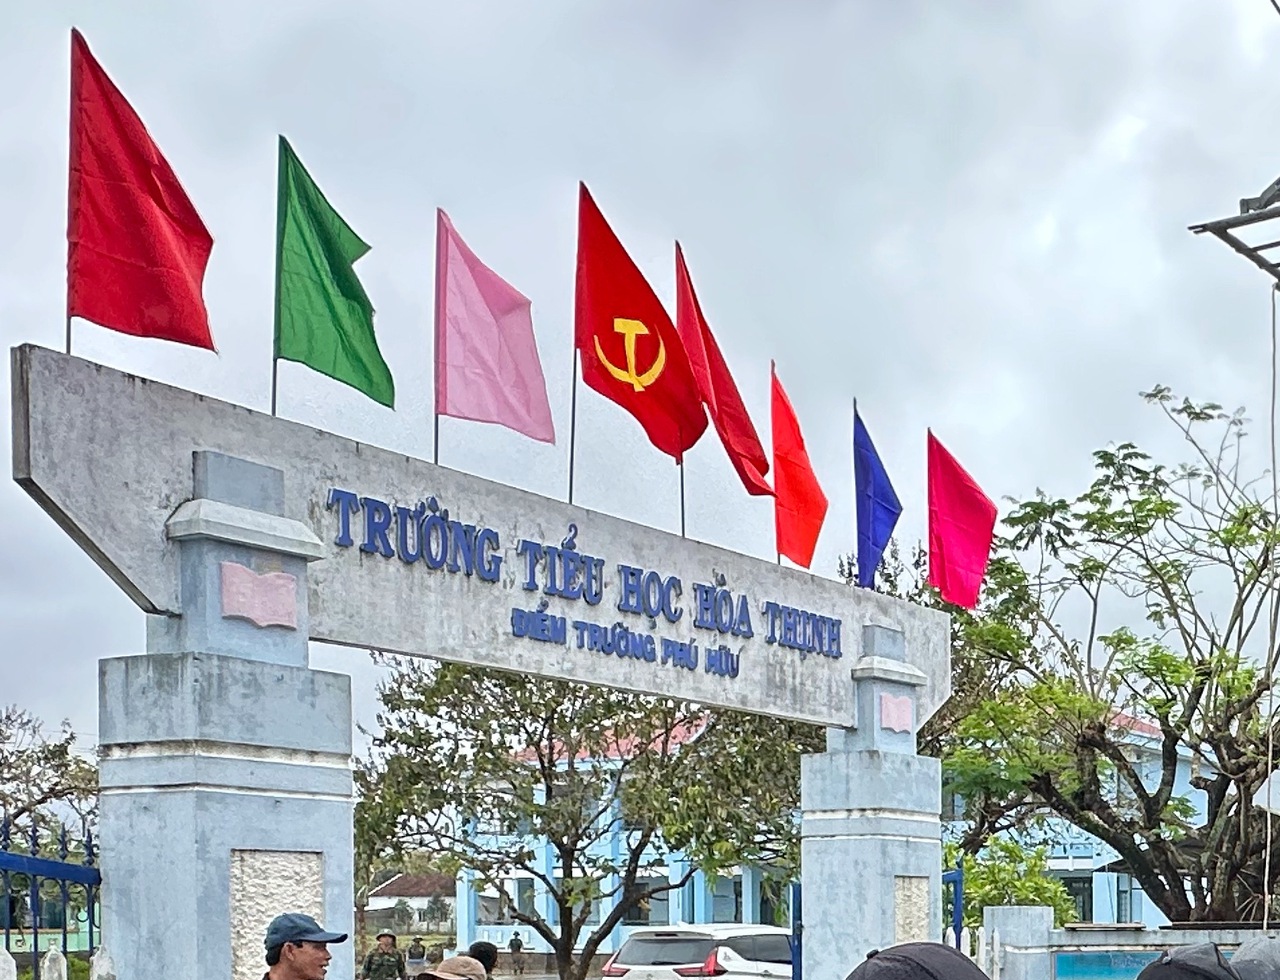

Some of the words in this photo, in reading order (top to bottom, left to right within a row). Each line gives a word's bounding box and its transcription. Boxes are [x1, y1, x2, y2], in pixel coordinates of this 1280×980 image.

[327, 488, 503, 583] TRƯỜNG
[517, 523, 604, 606] TIỂU
[618, 564, 683, 630] HỌC
[693, 573, 754, 639] HÒA
[763, 601, 843, 660] THỊNH
[512, 600, 567, 645] ĐIỂM
[573, 621, 657, 663] TRƯỜNG
[661, 638, 699, 671] PHÚ
